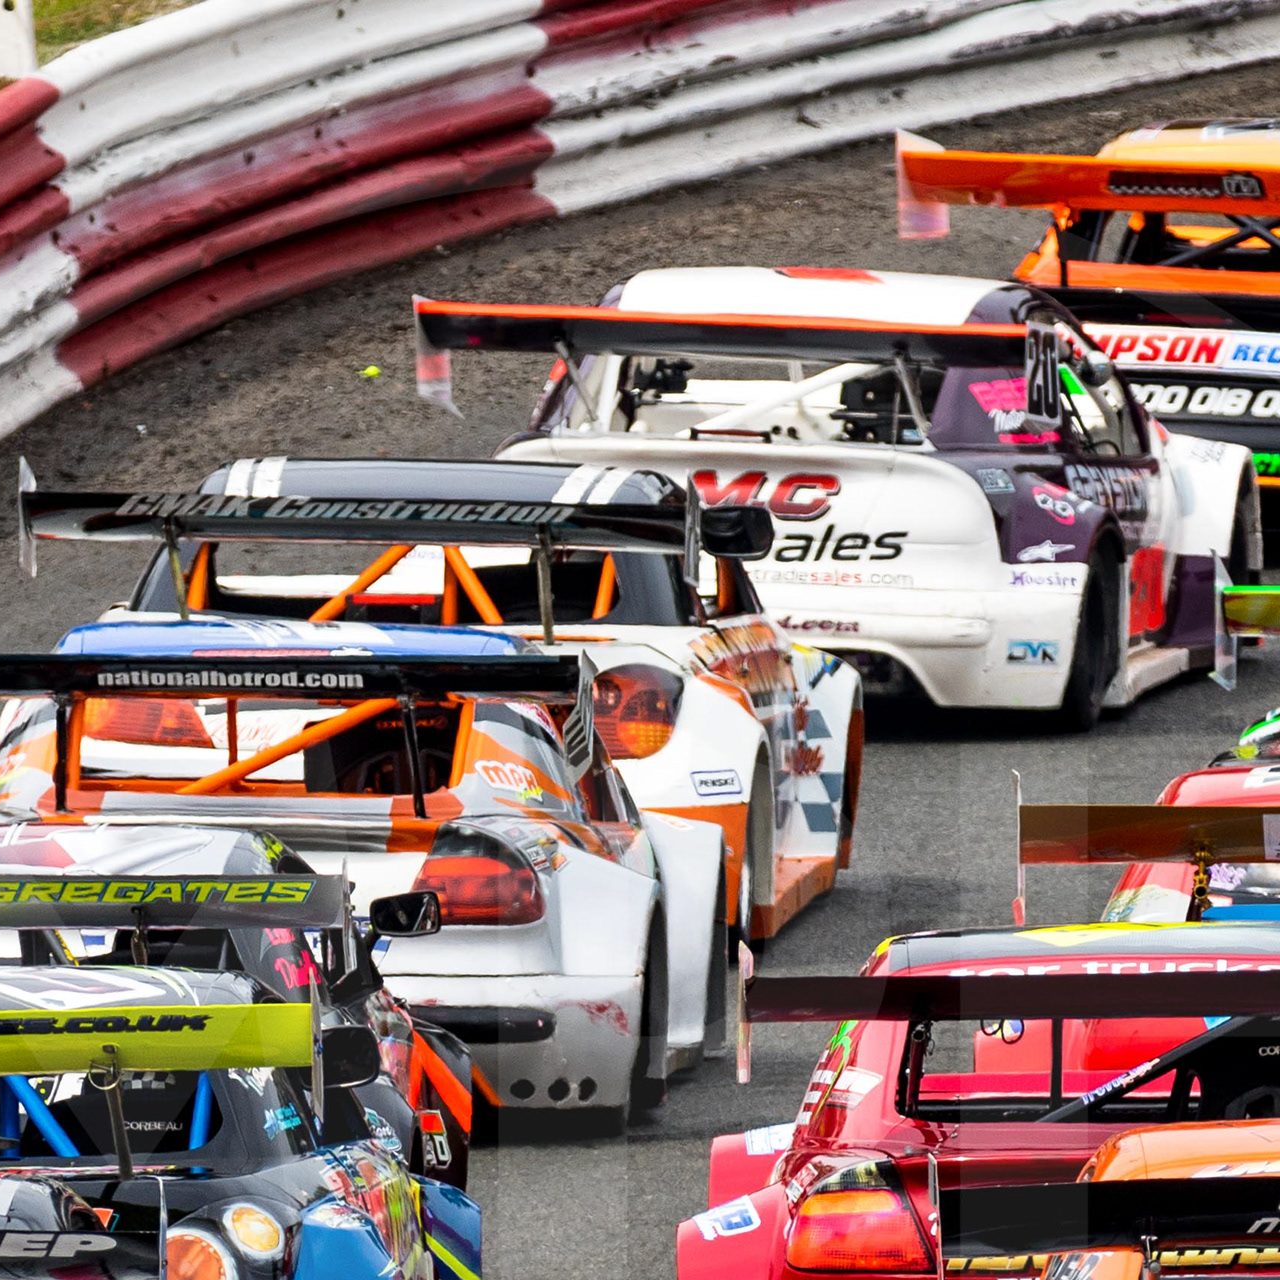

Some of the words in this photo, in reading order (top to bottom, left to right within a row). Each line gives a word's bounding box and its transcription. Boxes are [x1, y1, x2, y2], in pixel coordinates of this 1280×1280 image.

[266, 495, 578, 524] Construction
[773, 524, 910, 562] ales
[96, 668, 366, 692] nationalhotrod.com
